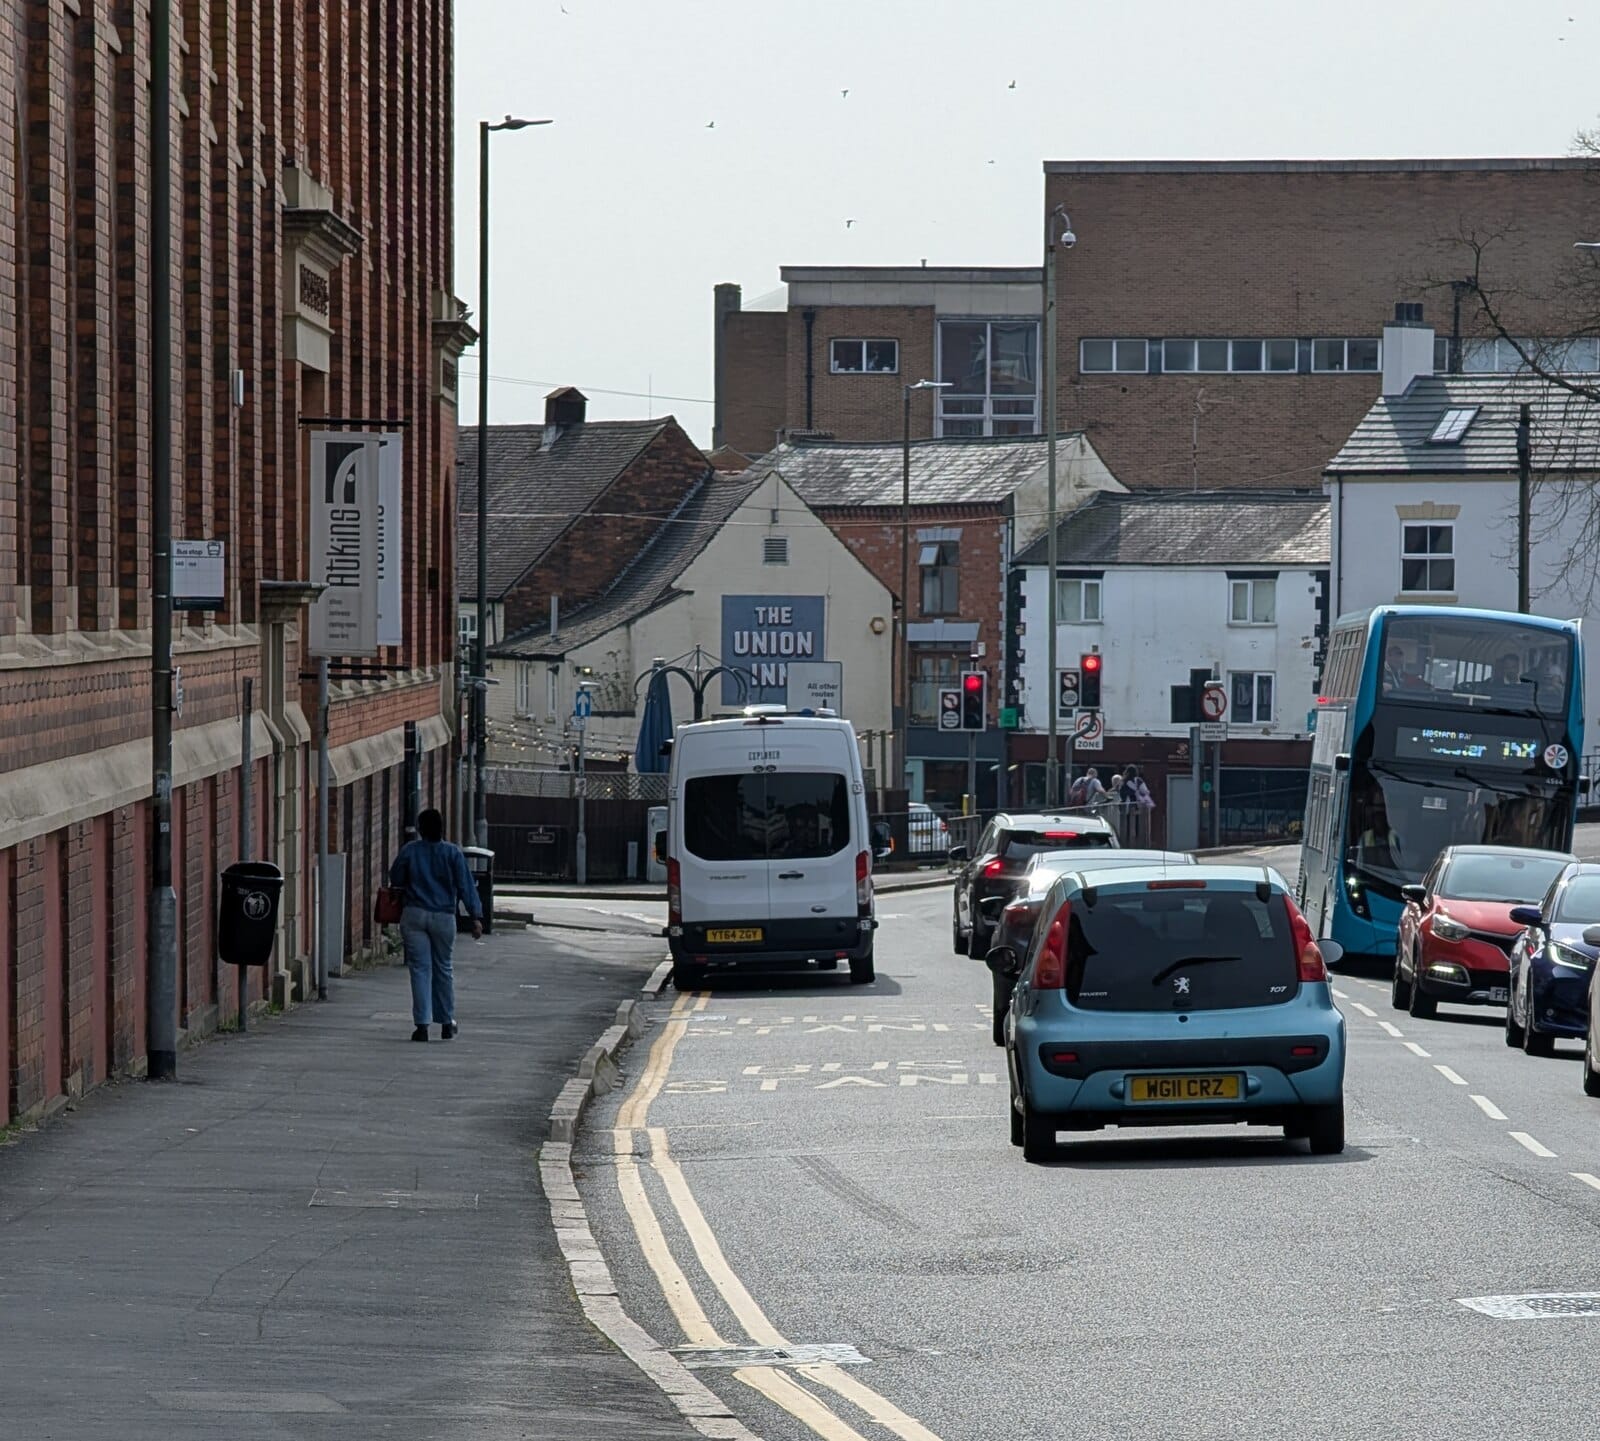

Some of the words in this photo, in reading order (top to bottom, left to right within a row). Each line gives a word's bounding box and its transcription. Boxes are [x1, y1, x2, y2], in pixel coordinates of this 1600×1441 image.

[188, 548, 203, 556] stop
[755, 606, 793, 625] THE
[733, 630, 813, 656] UNION
[807, 682, 818, 690] All
[818, 682, 838, 690] other
[1077, 740, 1100, 748] ZONE
[711, 930, 737, 941] YT64
[738, 928, 758, 940] ZGY
[1269, 985, 1288, 993] 107
[1146, 1079, 1183, 1098] WG11
[1186, 1078, 1224, 1097] CRZ
